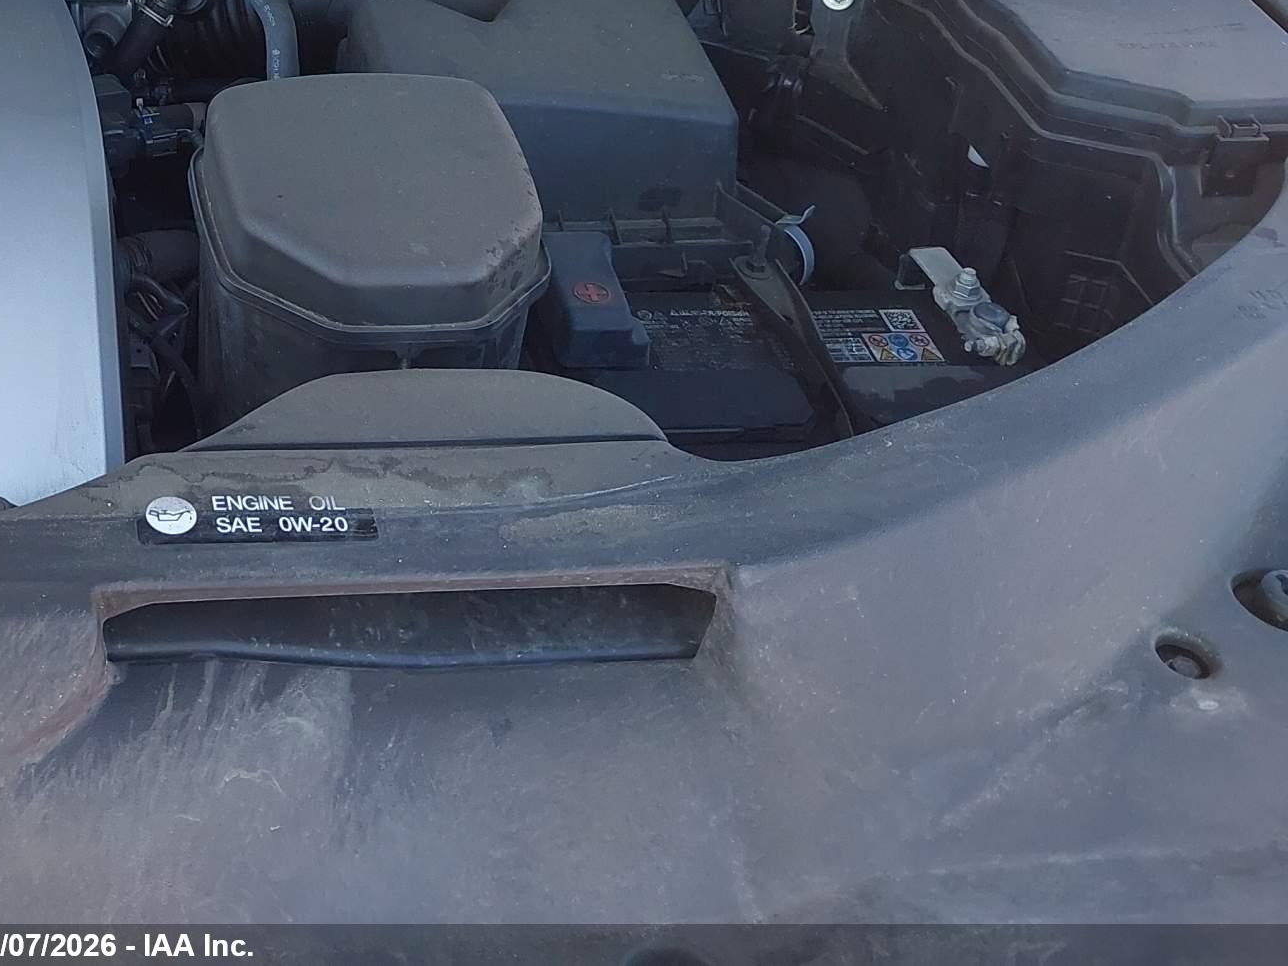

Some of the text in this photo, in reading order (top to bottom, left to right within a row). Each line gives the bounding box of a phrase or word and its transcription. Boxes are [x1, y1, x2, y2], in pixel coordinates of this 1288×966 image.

[211, 495, 346, 511] ENGINE OIL
[216, 516, 349, 533] SAE 0W-20
